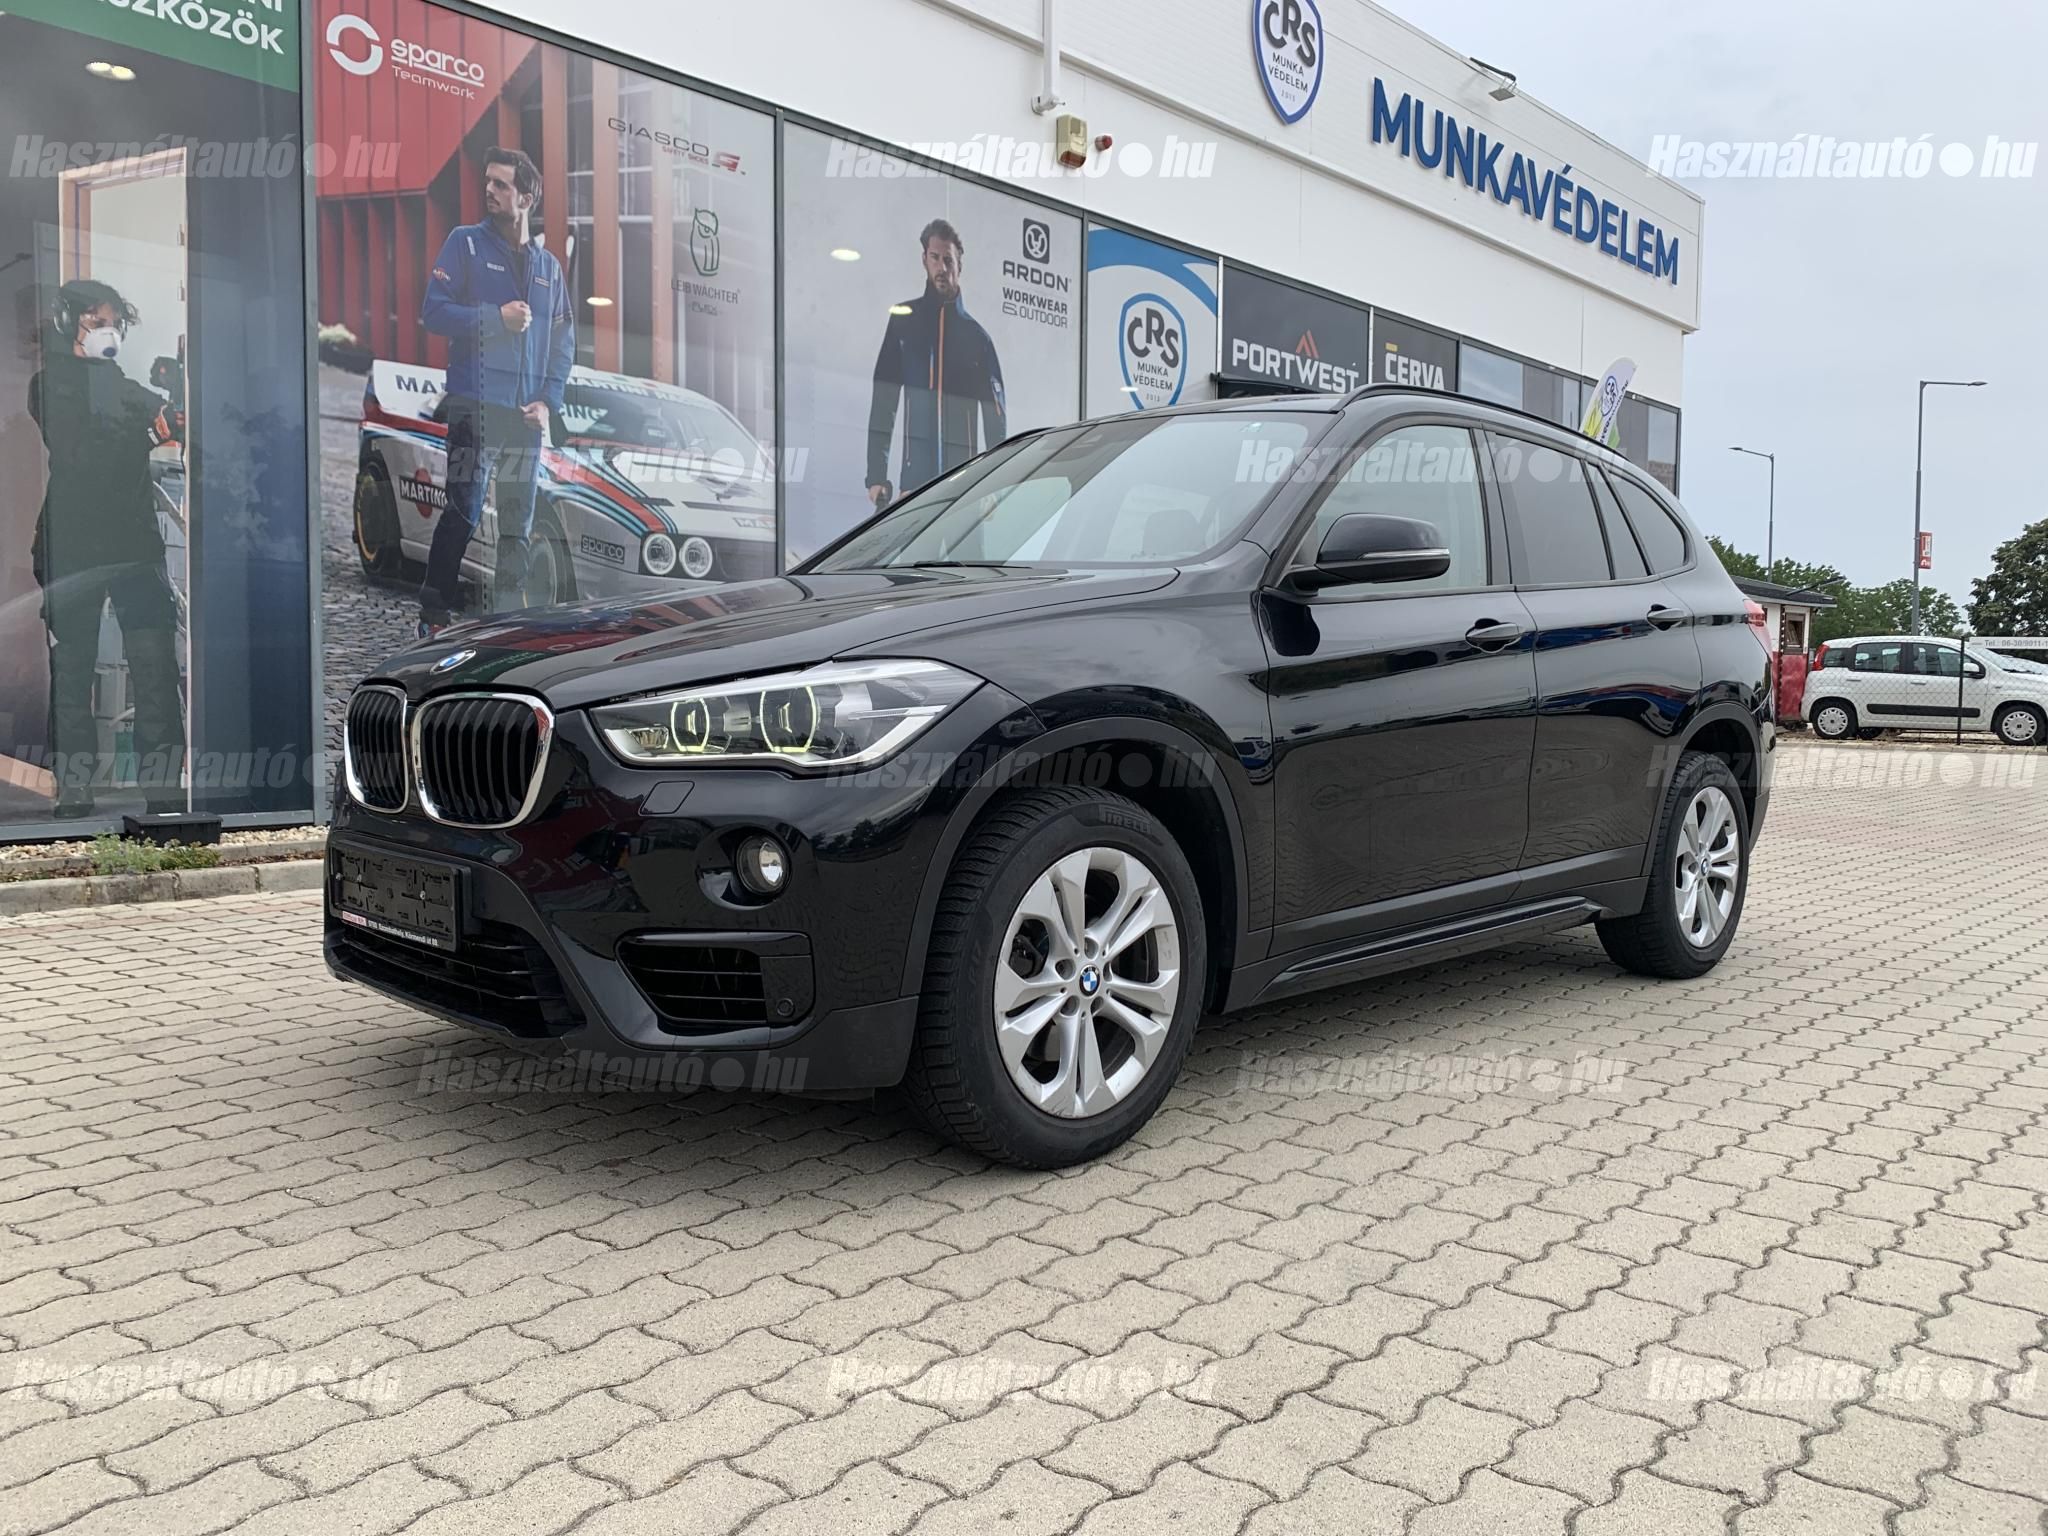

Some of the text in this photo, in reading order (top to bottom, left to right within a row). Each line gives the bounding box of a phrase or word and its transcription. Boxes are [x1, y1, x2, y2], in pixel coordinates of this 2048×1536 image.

[1263, 0, 1316, 68] CRS
[391, 38, 484, 83] sparco
[1272, 51, 1305, 77] MUNKA
[392, 65, 476, 100] Teamwork
[1267, 64, 1309, 93] VÉDELEM
[607, 117, 710, 157] GIASCO
[1371, 76, 1679, 286] MUNKAVÉDELEM
[1003, 260, 1069, 293] ARDON
[1002, 286, 1068, 315] WORKWEAR
[1019, 305, 1068, 329] OUTDOOR
[1127, 307, 1180, 369] CRS
[1136, 361, 1169, 378] MUNKA
[1232, 338, 1359, 394] PORTWEST
[395, 374, 447, 394] MA
[581, 536, 625, 561] sparco
